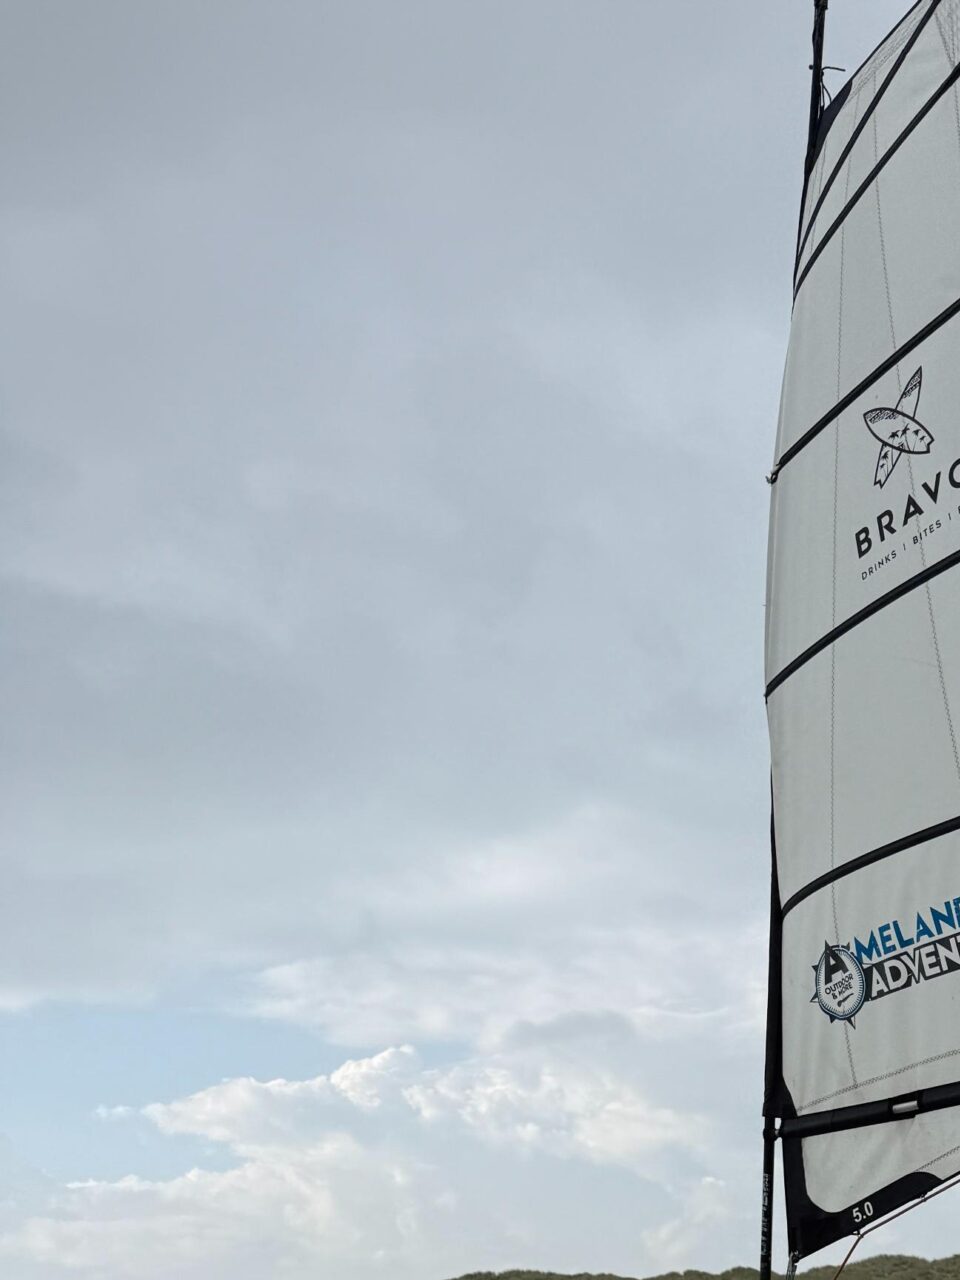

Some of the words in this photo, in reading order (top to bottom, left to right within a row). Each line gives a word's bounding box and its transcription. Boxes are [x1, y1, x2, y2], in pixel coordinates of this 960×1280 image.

[861, 550, 898, 581] DRINKS
[912, 519, 943, 545] BITES
[824, 973, 854, 995] OUTDOOR
[838, 981, 853, 996] MORE
[852, 1201, 874, 1223] 5.0
